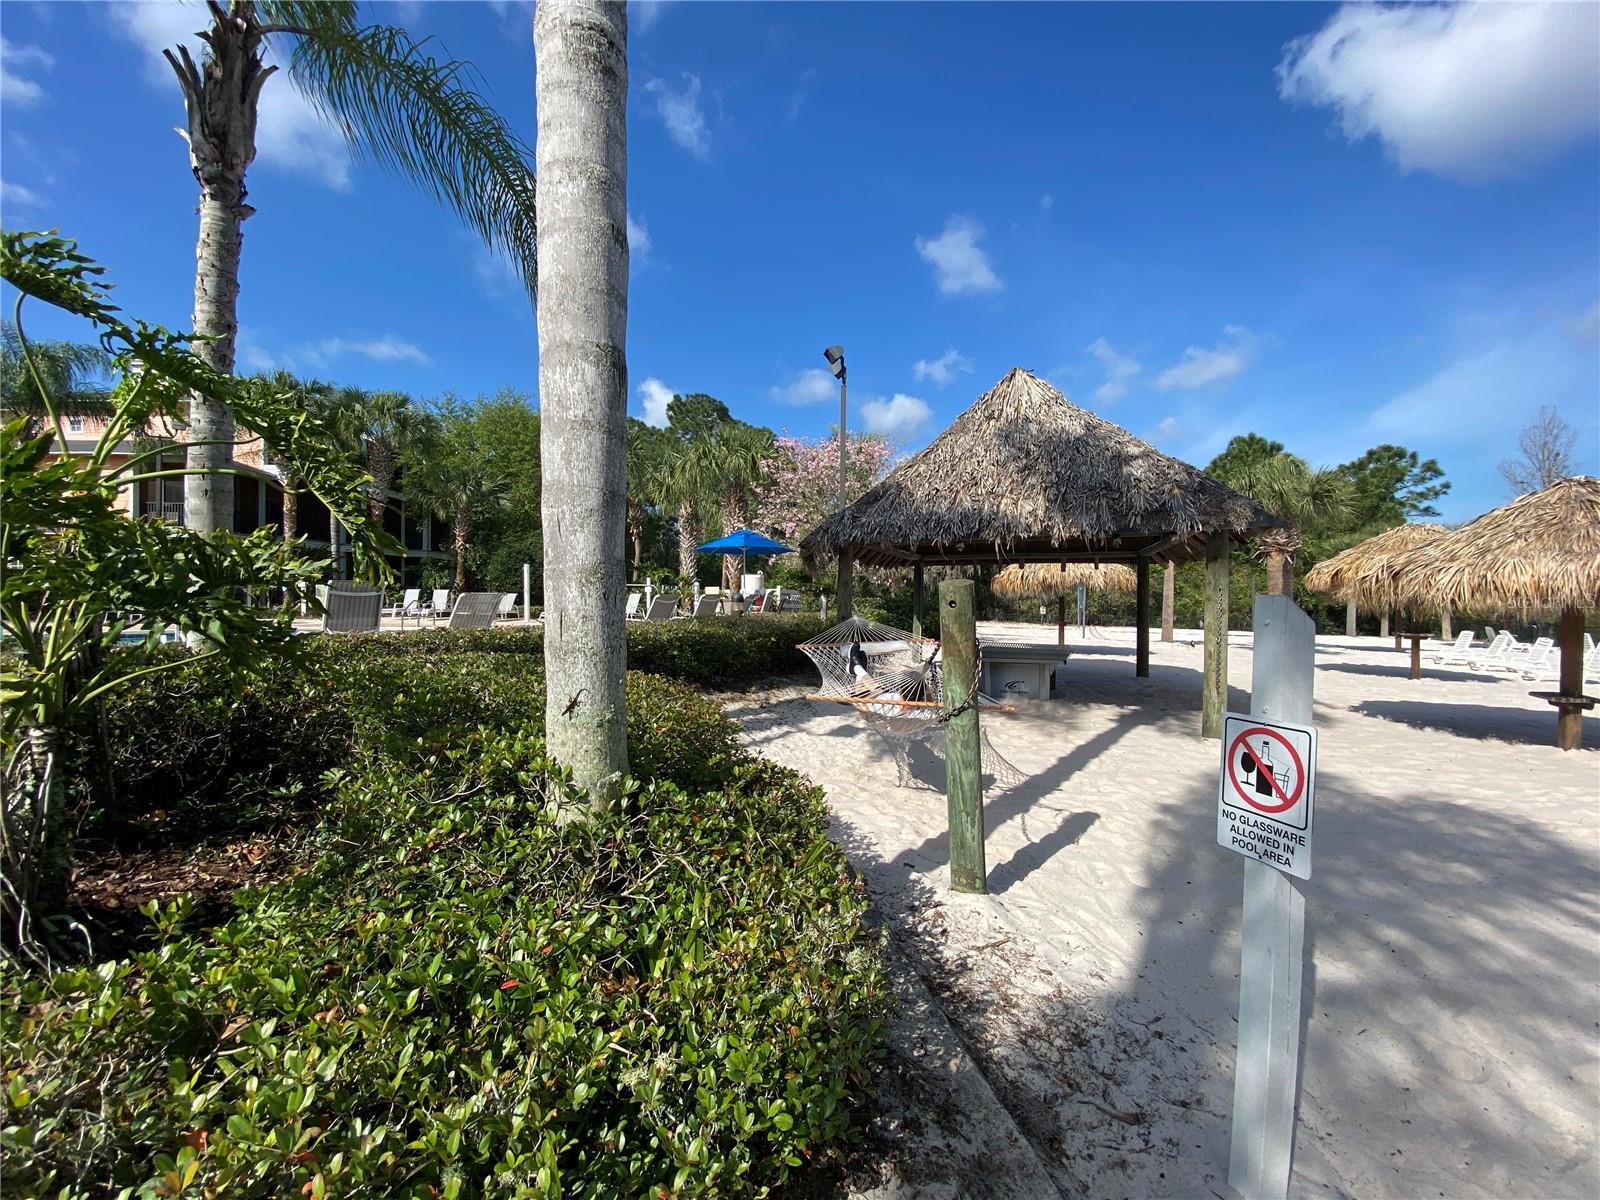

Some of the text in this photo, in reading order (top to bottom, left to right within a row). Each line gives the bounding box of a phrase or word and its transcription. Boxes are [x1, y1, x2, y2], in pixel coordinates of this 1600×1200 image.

[1222, 809, 1306, 847] NO GLASSWARE
[1230, 824, 1295, 857] ALLOWED IN
[1232, 836, 1292, 868] POOL AREA
